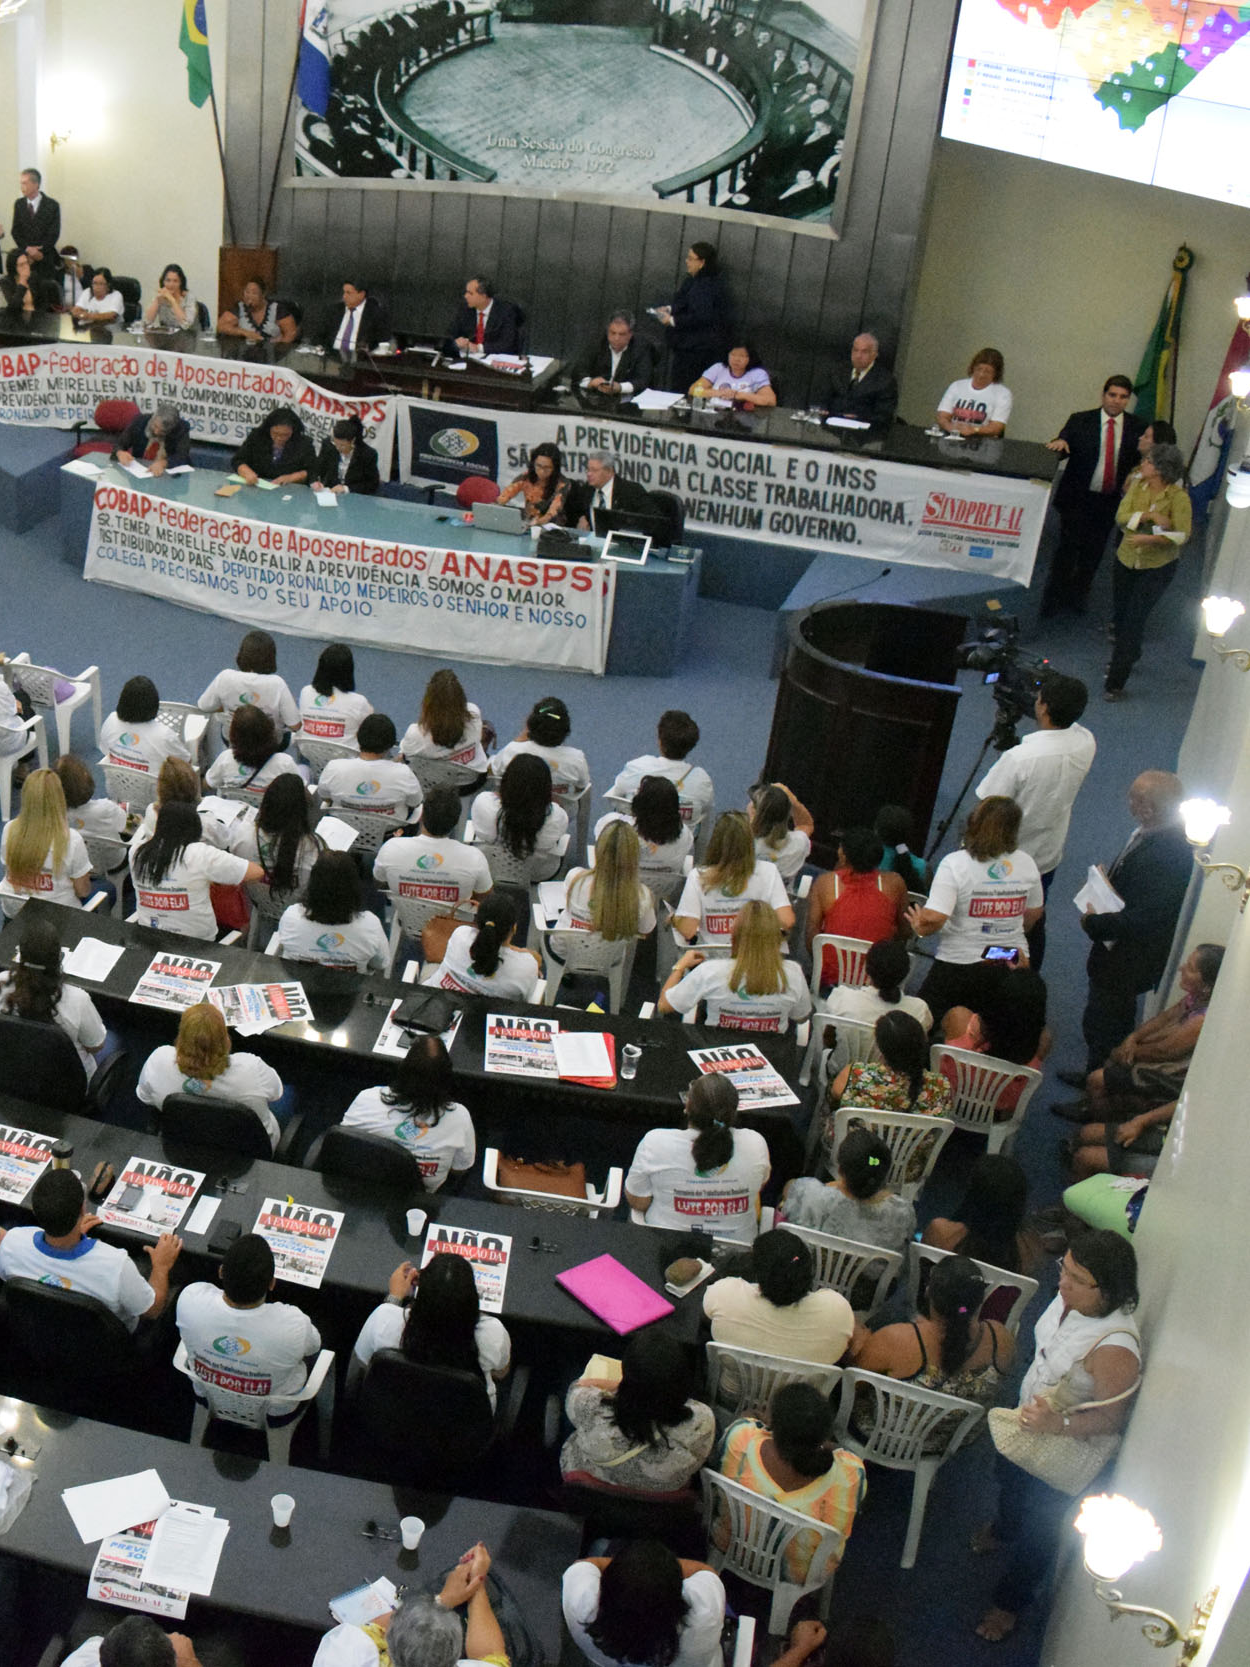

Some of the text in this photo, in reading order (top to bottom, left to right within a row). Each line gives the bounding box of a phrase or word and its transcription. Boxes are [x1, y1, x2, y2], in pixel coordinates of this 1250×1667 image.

[487, 134, 518, 149] Uma
[521, 135, 564, 152] Sessão
[145, 354, 168, 378] de
[174, 358, 293, 399] Aposentados
[47, 377, 117, 393] MEIRELLES
[182, 386, 258, 410] COMPROMISSO
[507, 443, 529, 468] SÃ
[658, 466, 681, 490] DA
[687, 471, 759, 504] CLASSE
[556, 425, 878, 492] A PREVIDÊNCIA SOCIAL E O INSS
[684, 497, 863, 546] NENHUM GOVERNO.
[116, 515, 151, 537] TEMER
[231, 546, 258, 564] VÃO
[261, 553, 301, 572] FALIR
[306, 560, 316, 574] A
[428, 576, 485, 599] SOMOS
[491, 586, 503, 600] O
[507, 587, 566, 609] MAIOR
[258, 526, 282, 551] de
[287, 529, 428, 572] Aposentados
[440, 551, 594, 592] ANASPS
[96, 546, 147, 569] COLEGA
[151, 556, 239, 595] PRECISAMOS
[246, 583, 268, 601] DO
[276, 589, 310, 609] SEU
[222, 560, 285, 585] DEPUTADO
[288, 572, 351, 596] RONALDO
[356, 583, 429, 607] MEDEIROS
[432, 593, 444, 608] O
[447, 596, 509, 620] SENHOR
[529, 608, 587, 629] NOSSO
[158, 955, 213, 978] NÃO
[495, 1017, 552, 1038] NÃO
[698, 1047, 759, 1070] NÃO
[131, 1161, 196, 1192] NÃO
[269, 1203, 335, 1233] NÃO
[677, 1200, 703, 1214] LUTE
[704, 1201, 725, 1216] POR
[437, 1228, 504, 1259] NÃO
